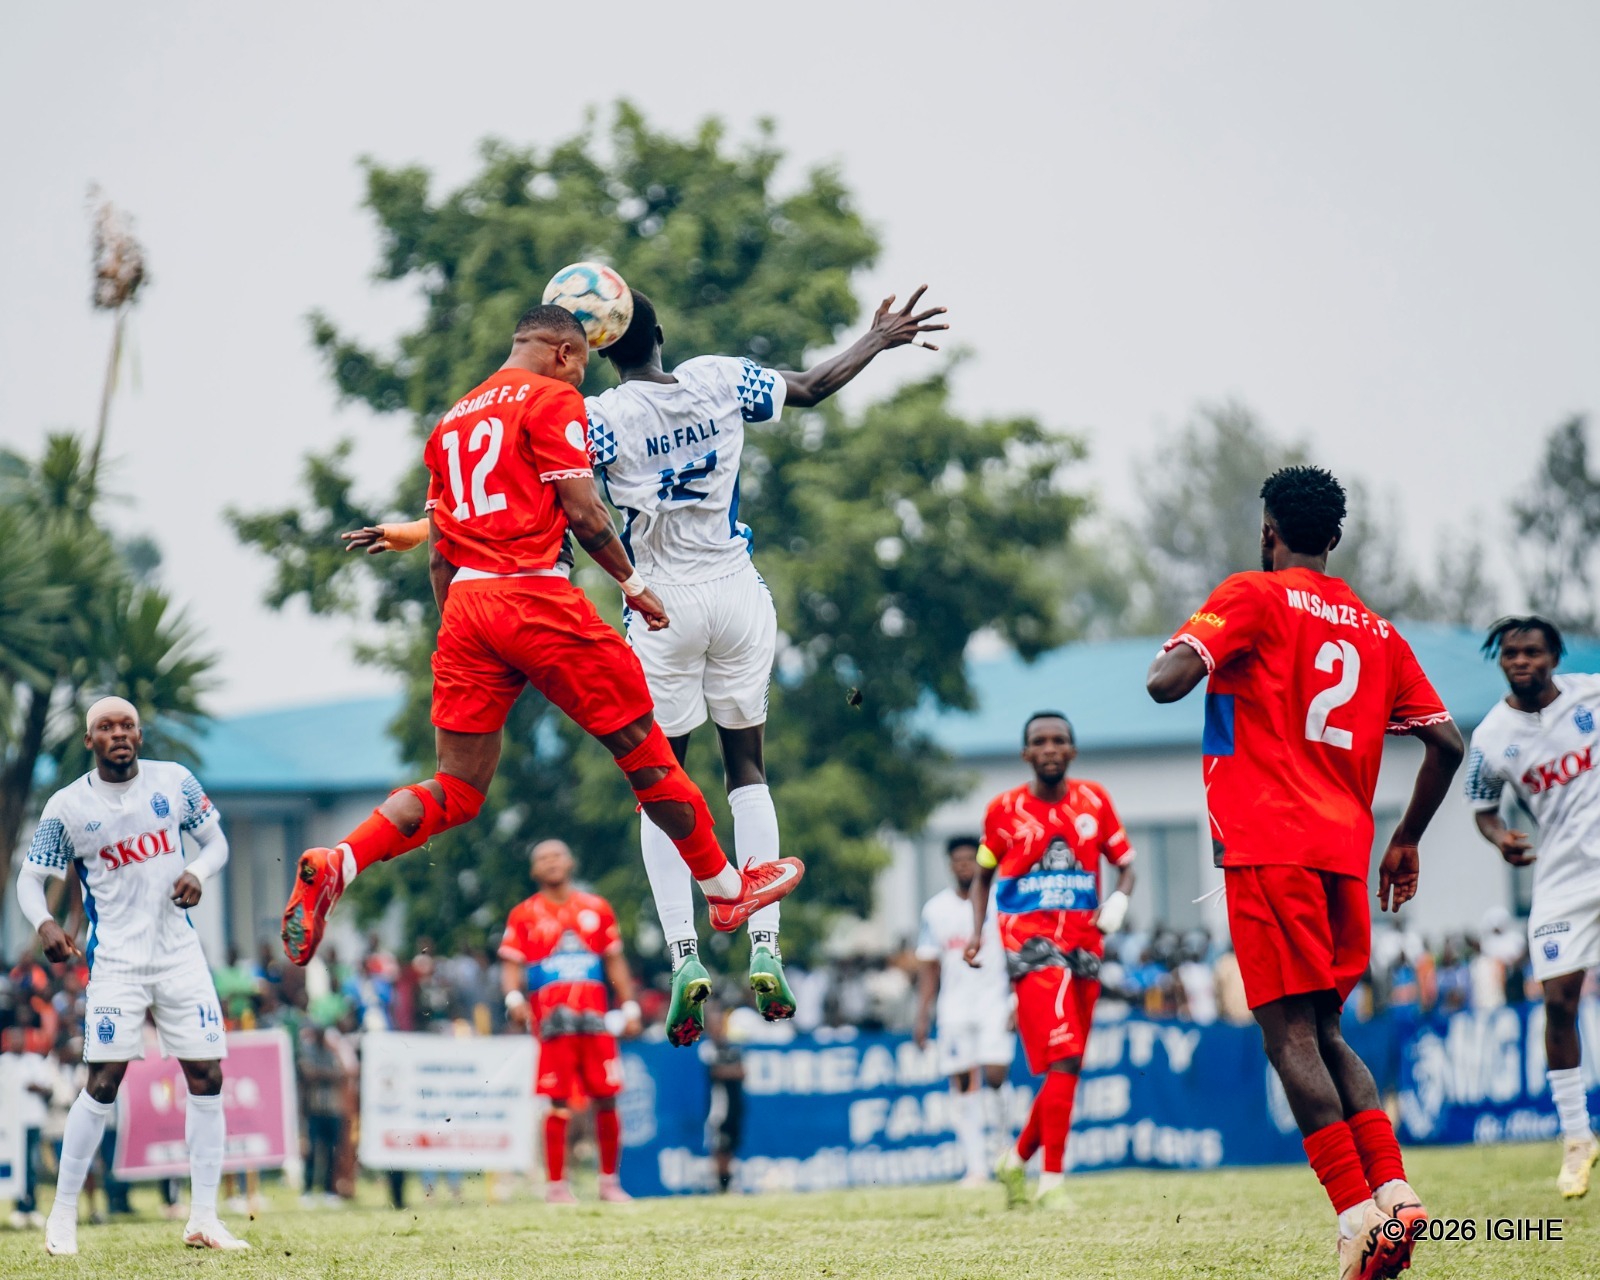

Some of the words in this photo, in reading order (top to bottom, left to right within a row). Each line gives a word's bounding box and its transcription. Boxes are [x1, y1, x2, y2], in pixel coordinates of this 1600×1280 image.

[497, 384, 531, 404] F.C
[645, 418, 720, 457] NG.FALL
[441, 416, 508, 522] 12
[1286, 588, 1360, 629] MUSANZE
[1305, 638, 1361, 751] 2
[99, 827, 176, 872] SKOL
[197, 1004, 219, 1028] 14
